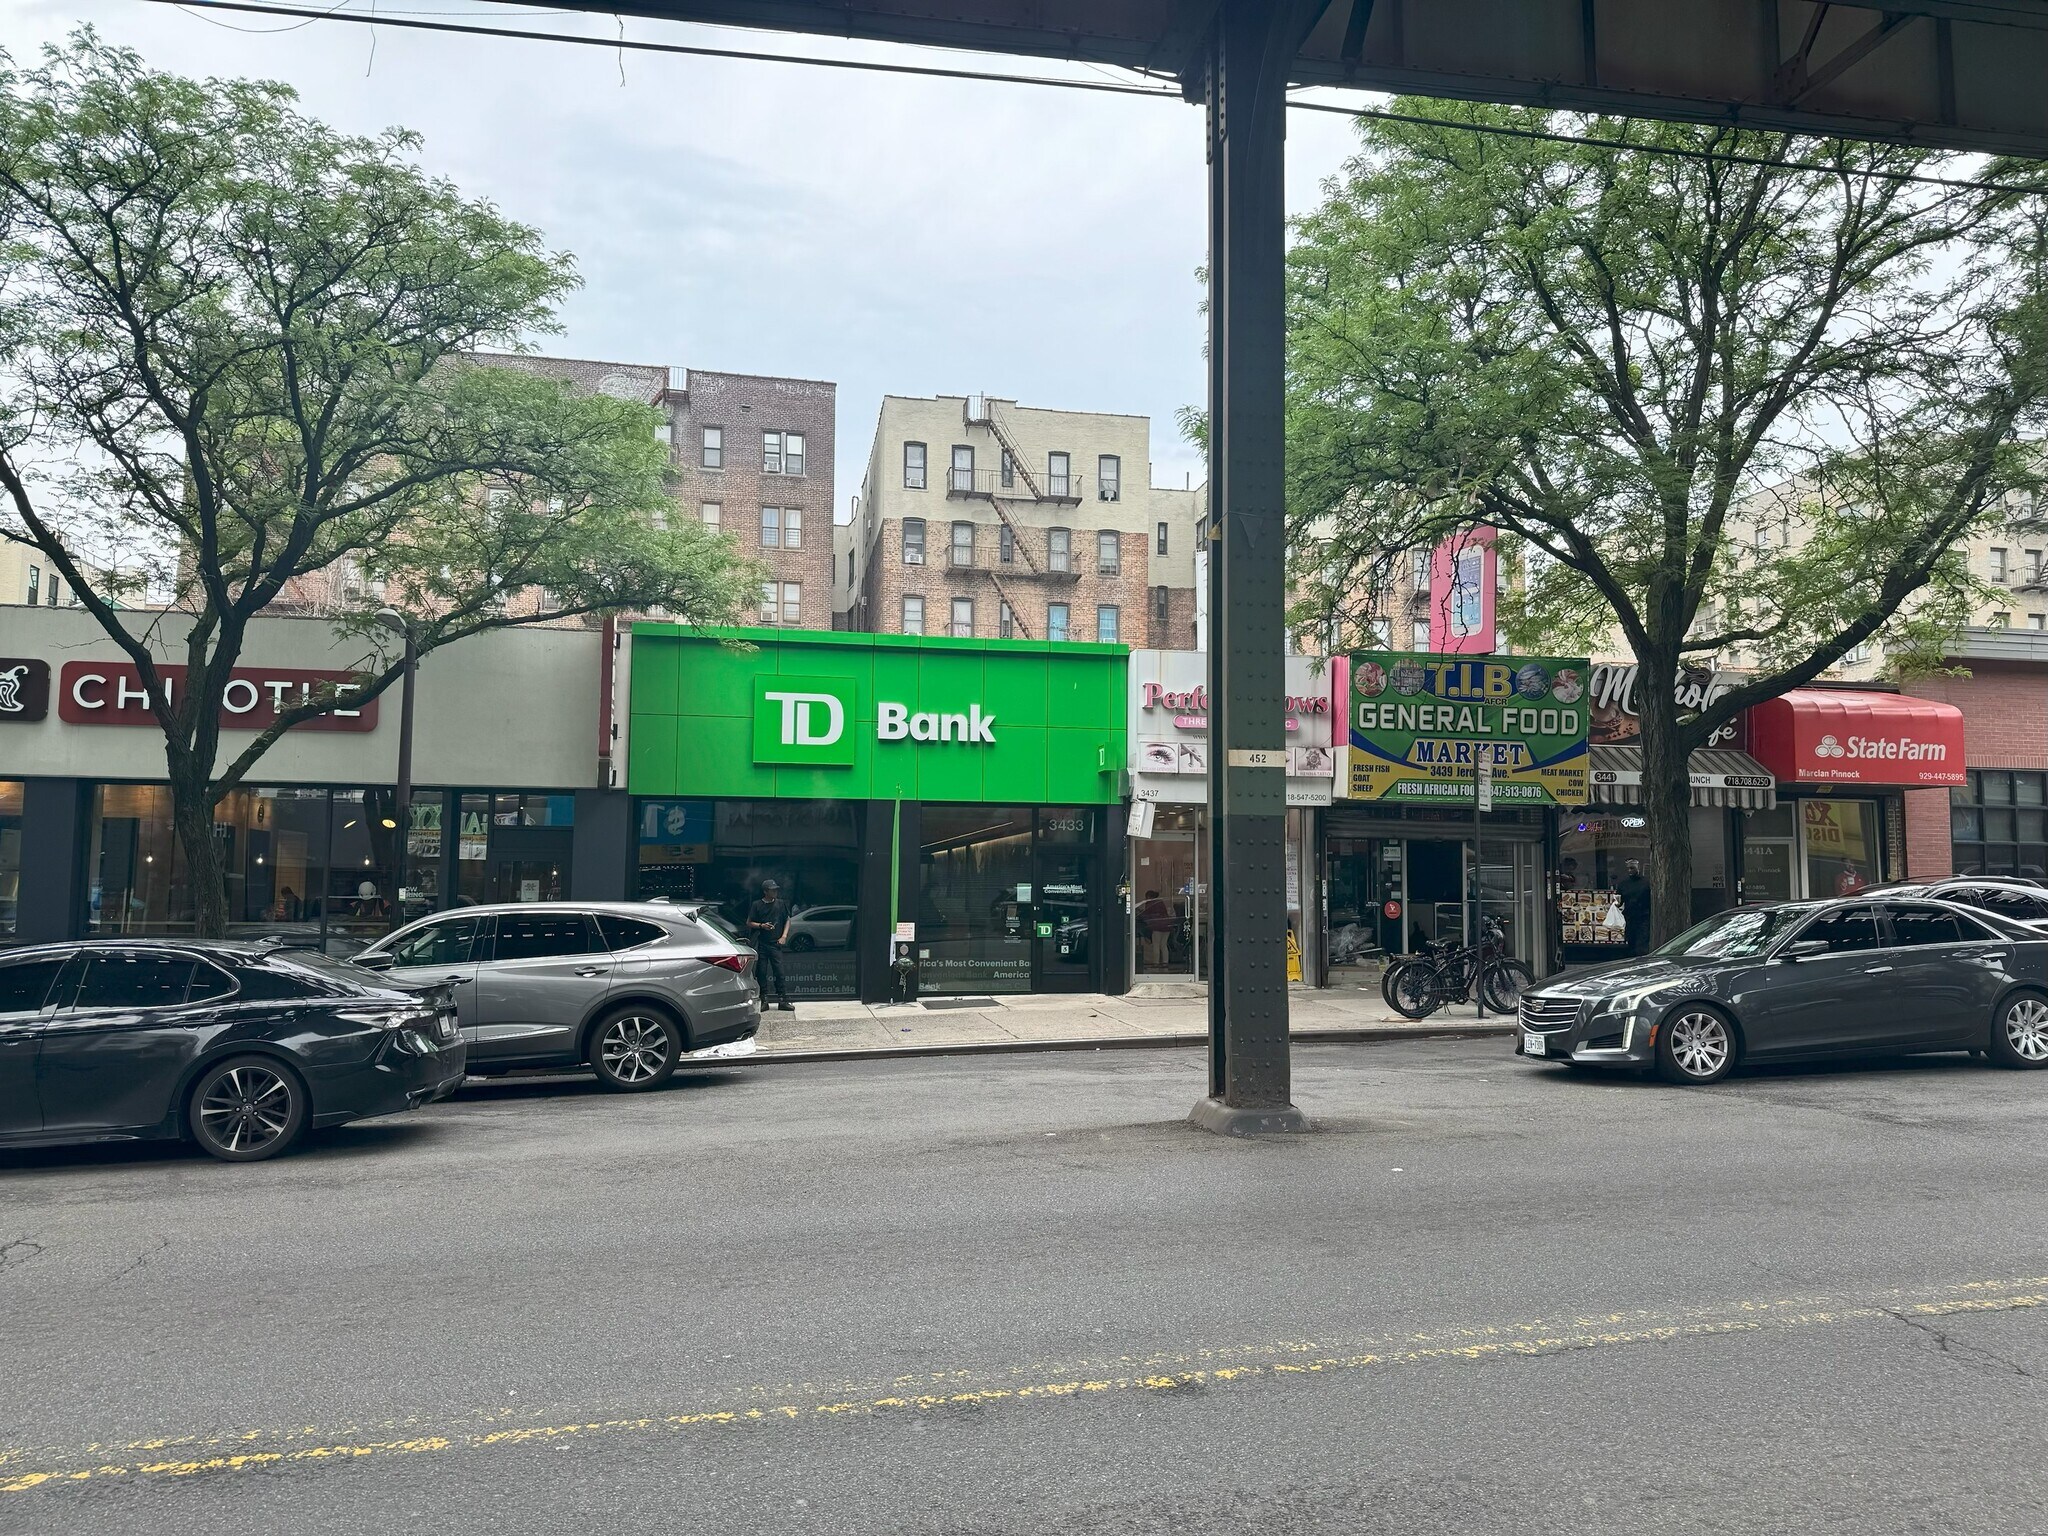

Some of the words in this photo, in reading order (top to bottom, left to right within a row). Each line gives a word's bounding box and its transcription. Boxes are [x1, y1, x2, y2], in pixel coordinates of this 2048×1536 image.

[72, 673, 361, 717] CHIOTLE
[1142, 682, 1208, 710] Perfe
[1284, 695, 1329, 714] ows
[765, 691, 844, 746] TD
[877, 702, 996, 743] Bank
[1358, 702, 1492, 733] GENERAL
[1502, 707, 1579, 735] FOOD
[1249, 754, 1267, 763] 452
[1353, 763, 1374, 773] FRESH
[1375, 764, 1390, 773] FISH
[1430, 765, 1453, 777] 3439
[1456, 766, 1475, 777] Jero
[1492, 767, 1510, 779] Ave.
[1541, 768, 1557, 777] MEAT
[1559, 769, 1584, 778] MARKET
[1353, 774, 1370, 782] GOAT
[1831, 769, 1860, 779] Pinnock
[1918, 772, 1964, 781] 929-447-5895
[1568, 779, 1584, 787] COW
[1596, 773, 1616, 782] 3441
[1690, 776, 1711, 784] UNCH
[1726, 777, 1769, 786] 718.708.6250
[1141, 789, 1159, 797] 3437
[1353, 784, 1374, 792] SHEEP
[1397, 782, 1423, 795] FRESH
[1423, 783, 1458, 796] AFRICAN
[1460, 784, 1475, 796] FOO
[1556, 788, 1584, 797] CHICKEN
[1049, 819, 1084, 831] 3433
[1623, 818, 1643, 828] OPEN
[1039, 925, 1051, 935] TD
[945, 959, 966, 967] Most
[968, 959, 1017, 967] Convenient
[1019, 959, 1031, 967] Ba
[815, 973, 838, 982] Bank
[794, 985, 840, 993] America's
